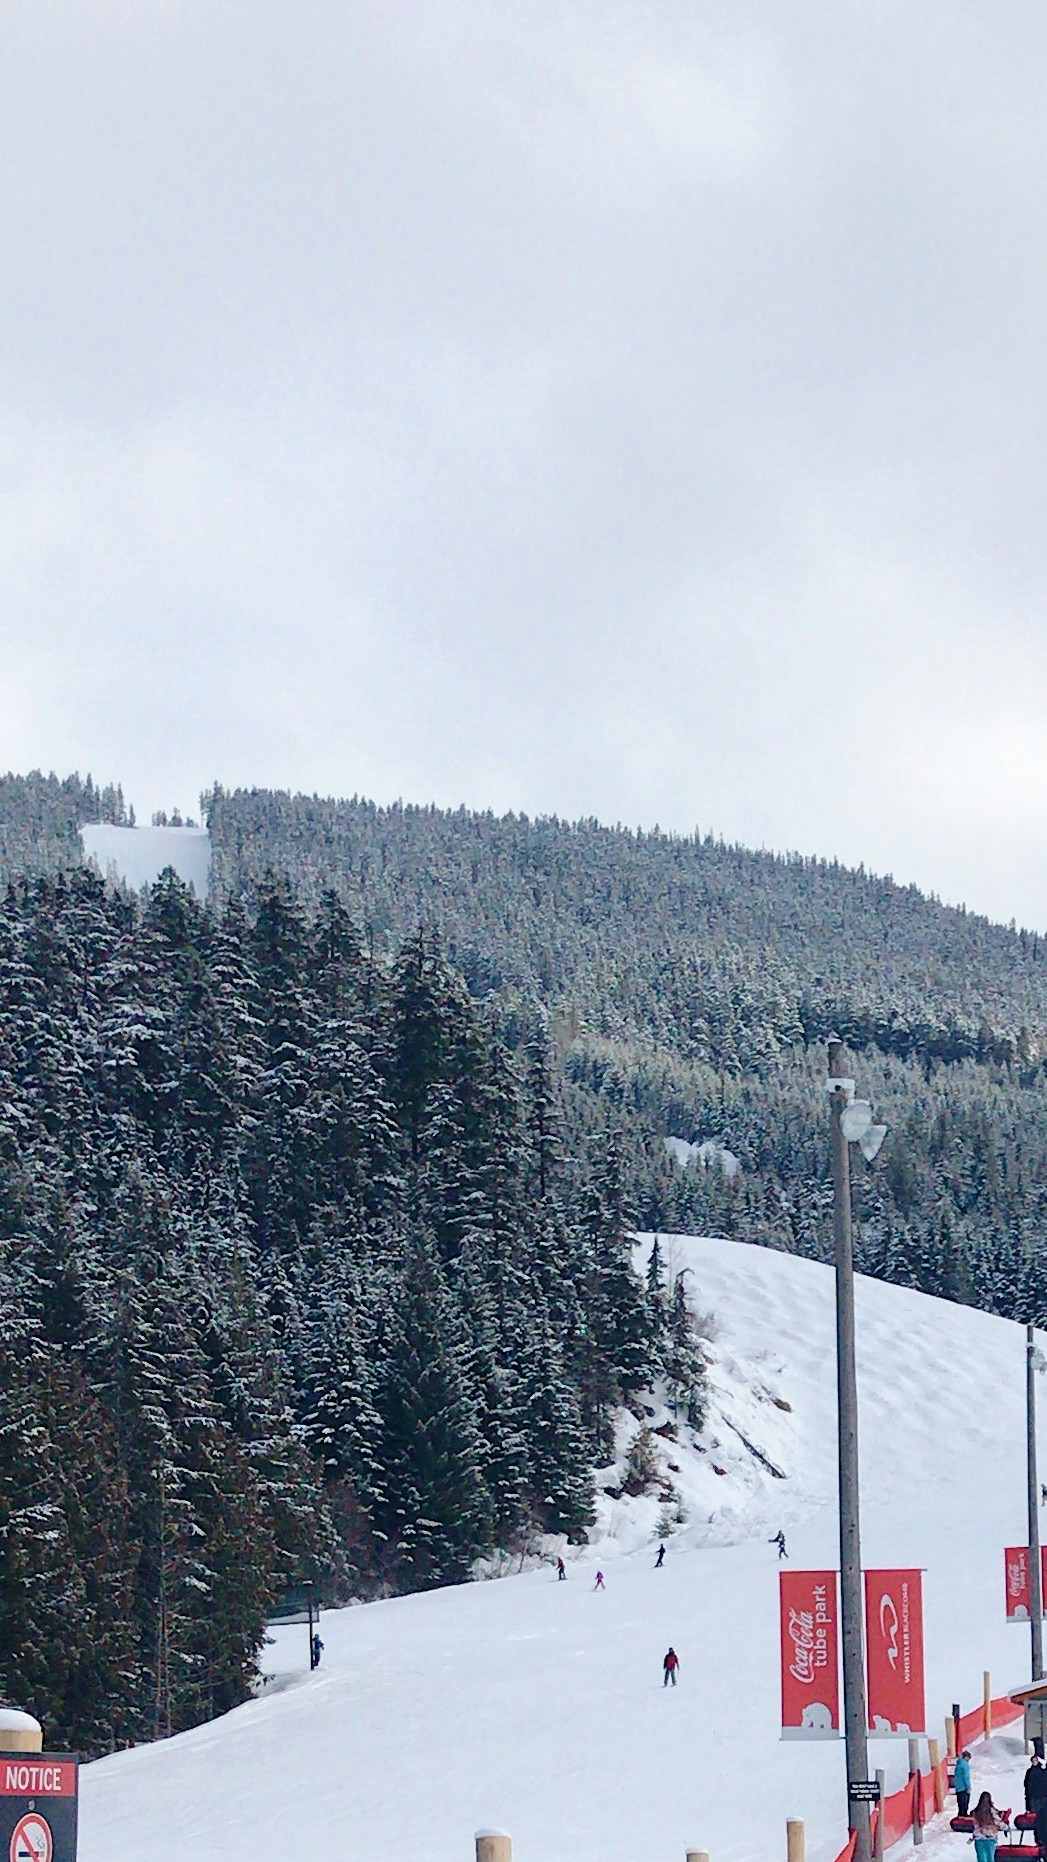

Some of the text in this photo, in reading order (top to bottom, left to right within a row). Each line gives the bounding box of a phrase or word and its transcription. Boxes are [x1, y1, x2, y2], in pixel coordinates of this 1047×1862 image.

[812, 1584, 832, 1668] tube park
[902, 1633, 911, 1684] WHISTLER
[5, 1766, 62, 1791] NOTICE
